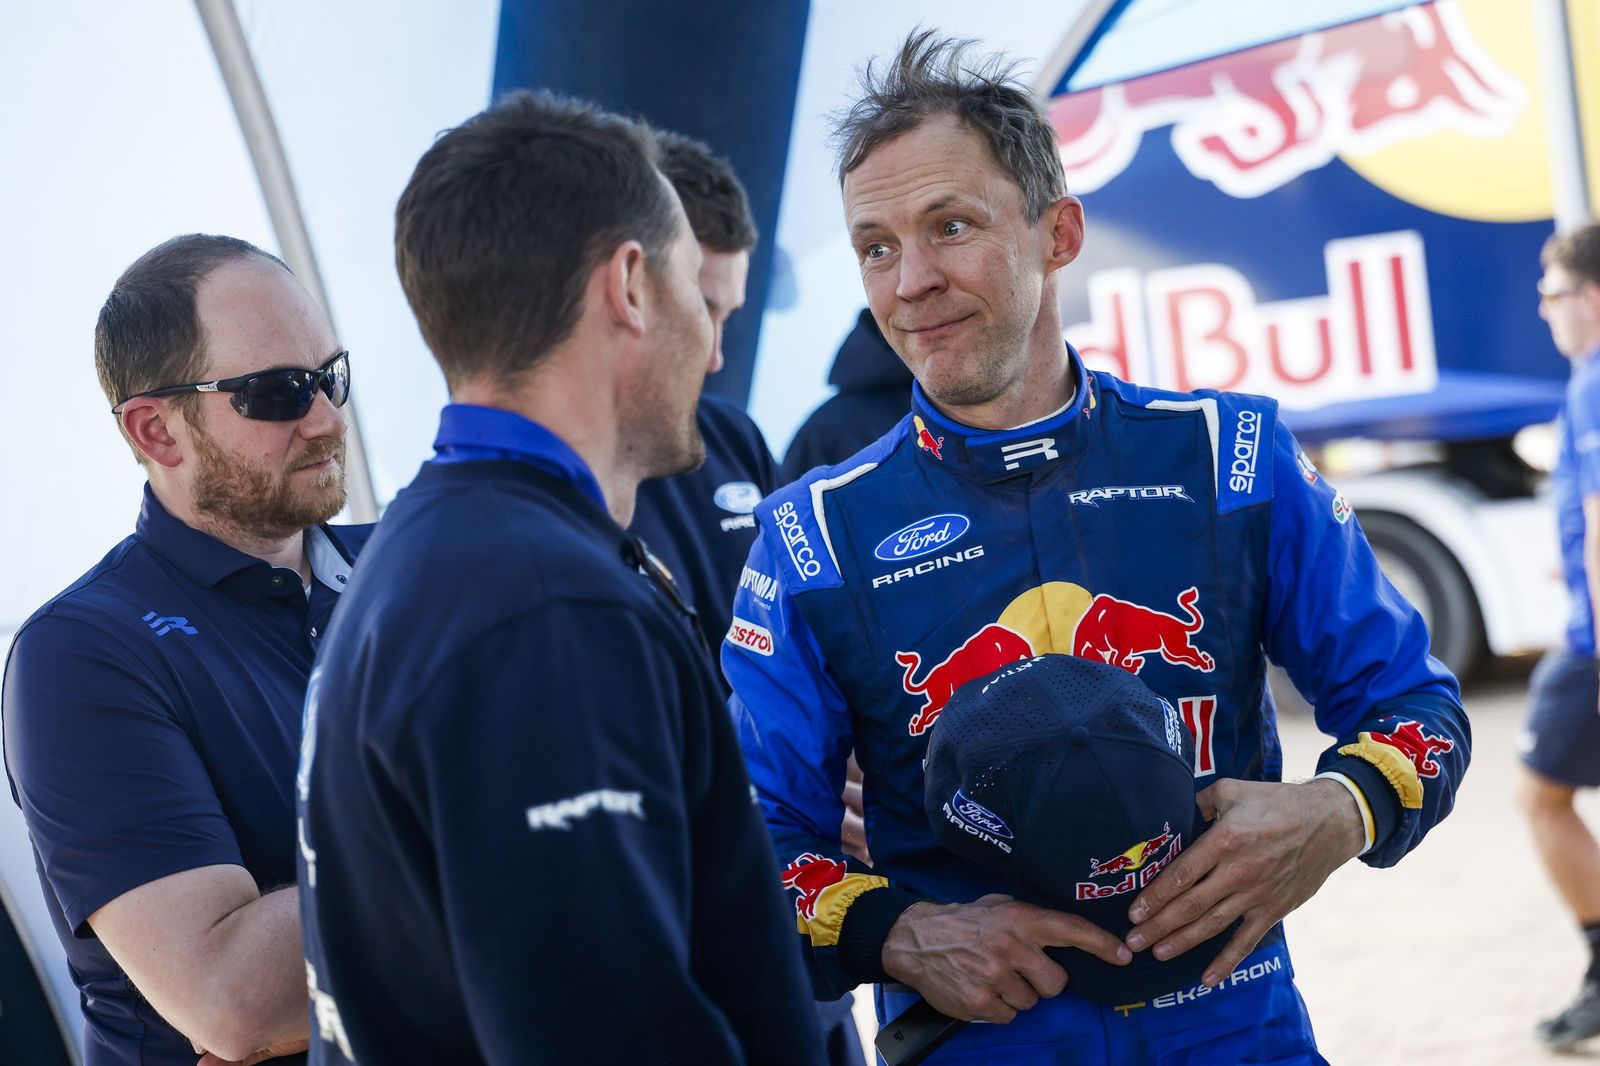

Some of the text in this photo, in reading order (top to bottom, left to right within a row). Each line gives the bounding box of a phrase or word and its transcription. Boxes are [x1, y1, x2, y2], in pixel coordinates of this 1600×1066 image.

[1163, 248, 1420, 398] Bull
[1229, 410, 1262, 494] sparco
[1067, 484, 1195, 508] RAPTOR
[773, 501, 821, 582] sparco
[893, 521, 951, 556] Ford
[739, 565, 778, 602] OPTIMA
[872, 545, 985, 589] RACING
[731, 625, 771, 652] astrol
[942, 802, 1012, 854] RACING
[959, 802, 1002, 832] Ford
[1076, 872, 1136, 900] Red
